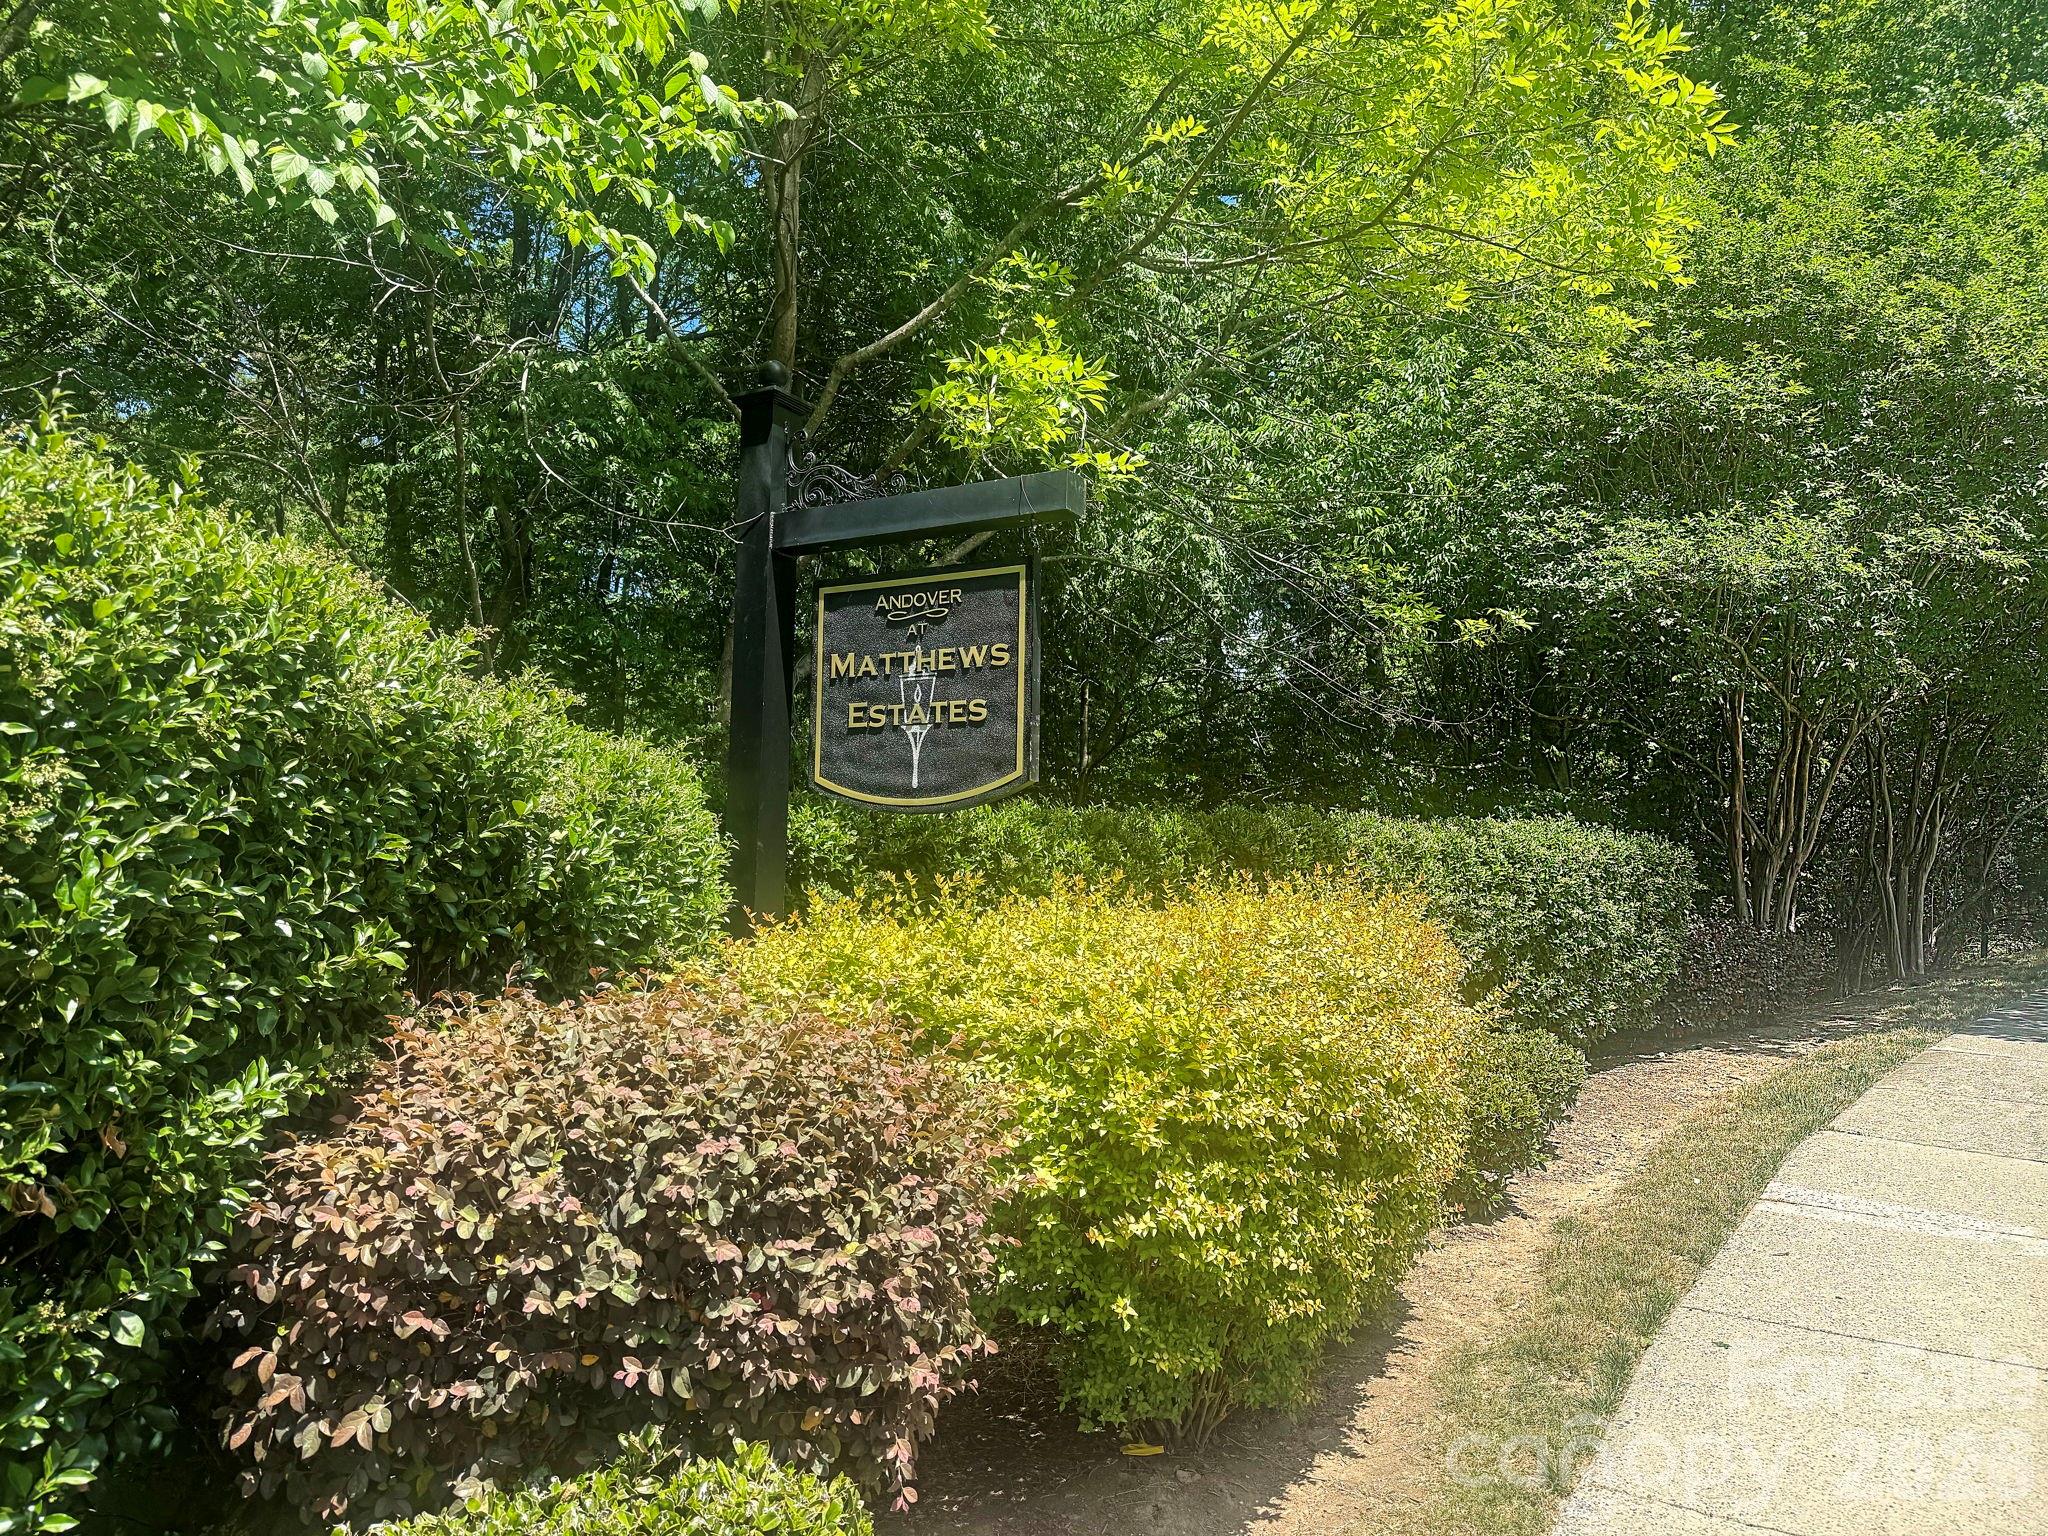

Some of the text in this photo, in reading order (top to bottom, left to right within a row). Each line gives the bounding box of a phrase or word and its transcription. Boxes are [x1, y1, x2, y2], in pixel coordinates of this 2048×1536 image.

[875, 588, 962, 610] ANDOVER
[907, 623, 928, 636] AT
[830, 643, 1011, 679] MATTHEWS
[848, 698, 988, 728] ESTATES
